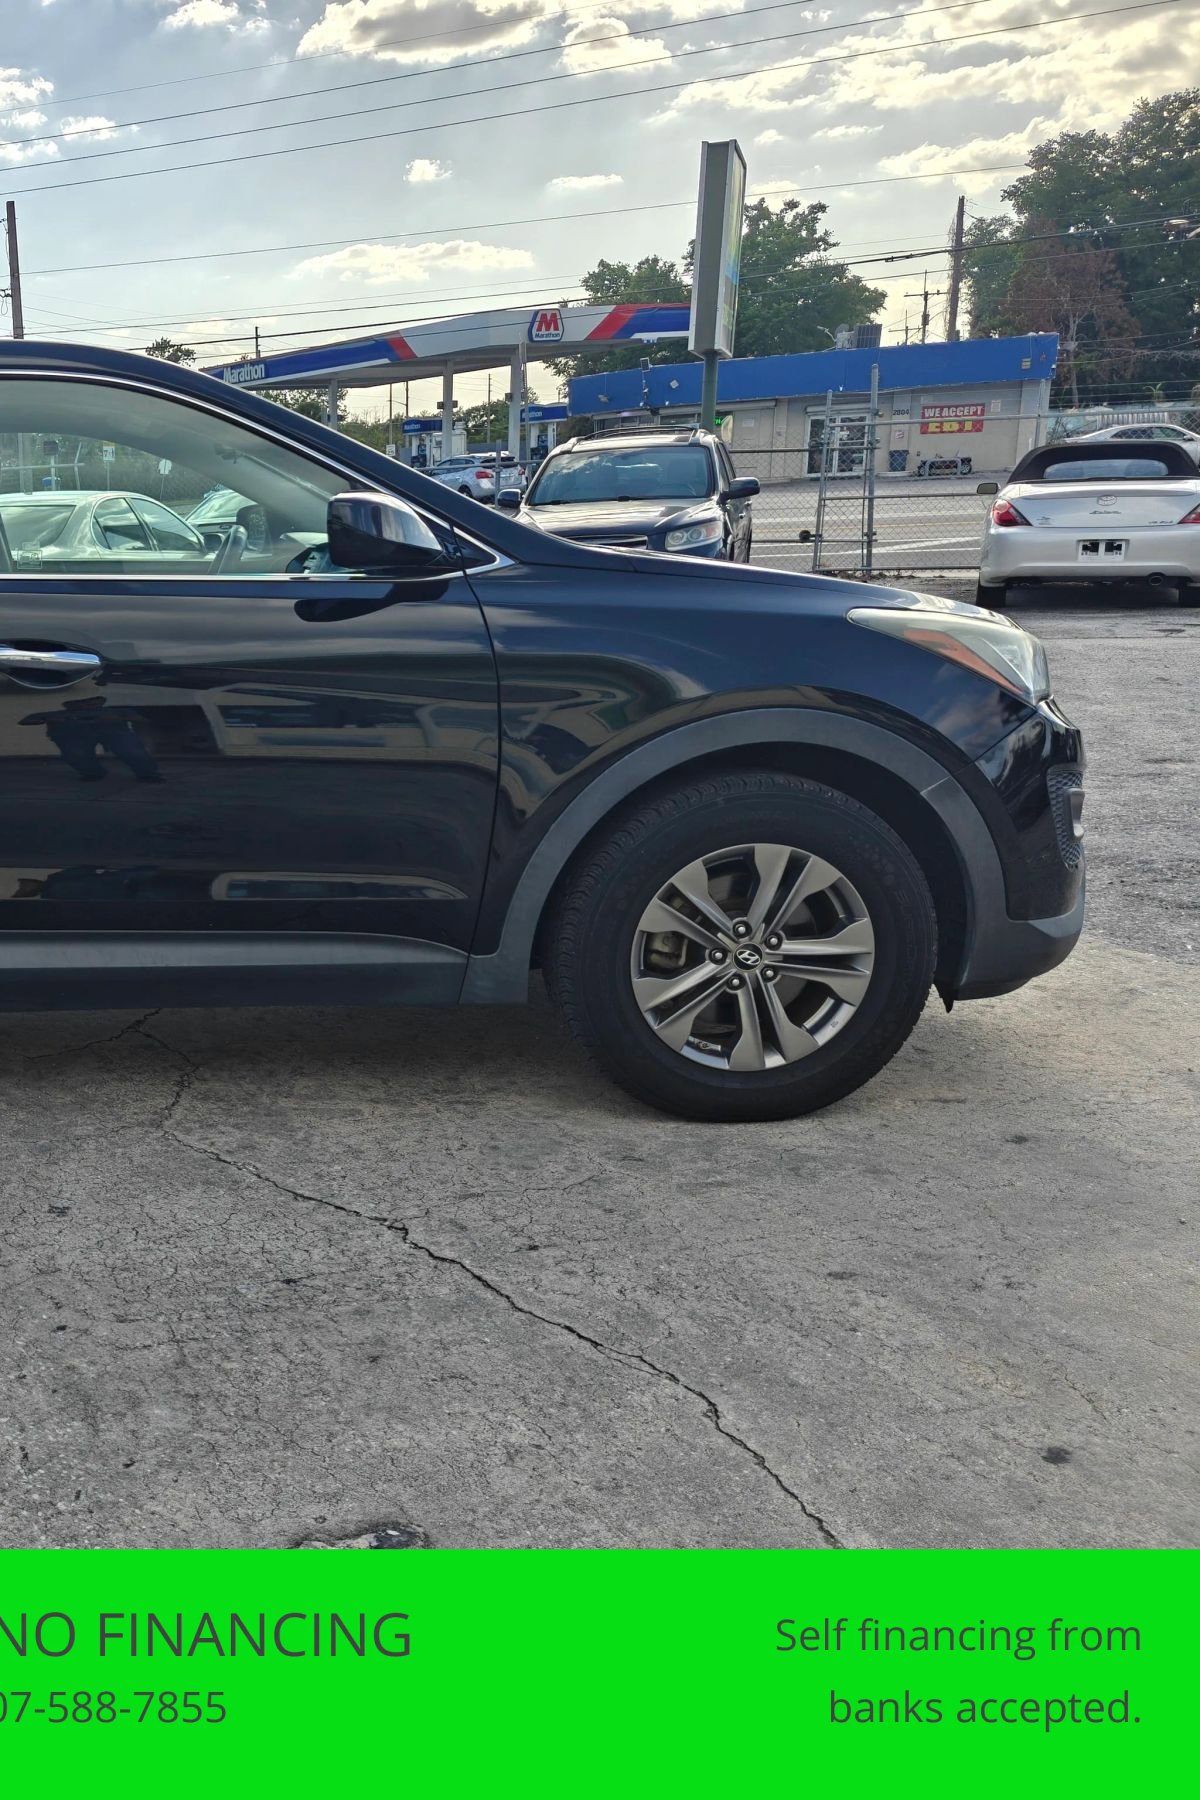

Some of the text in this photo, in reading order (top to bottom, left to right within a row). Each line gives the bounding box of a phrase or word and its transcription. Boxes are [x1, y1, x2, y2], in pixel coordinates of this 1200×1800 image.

[536, 313, 559, 332] M
[223, 363, 265, 384] Marathon
[924, 407, 941, 417] WE
[942, 406, 983, 417] ACCEPT
